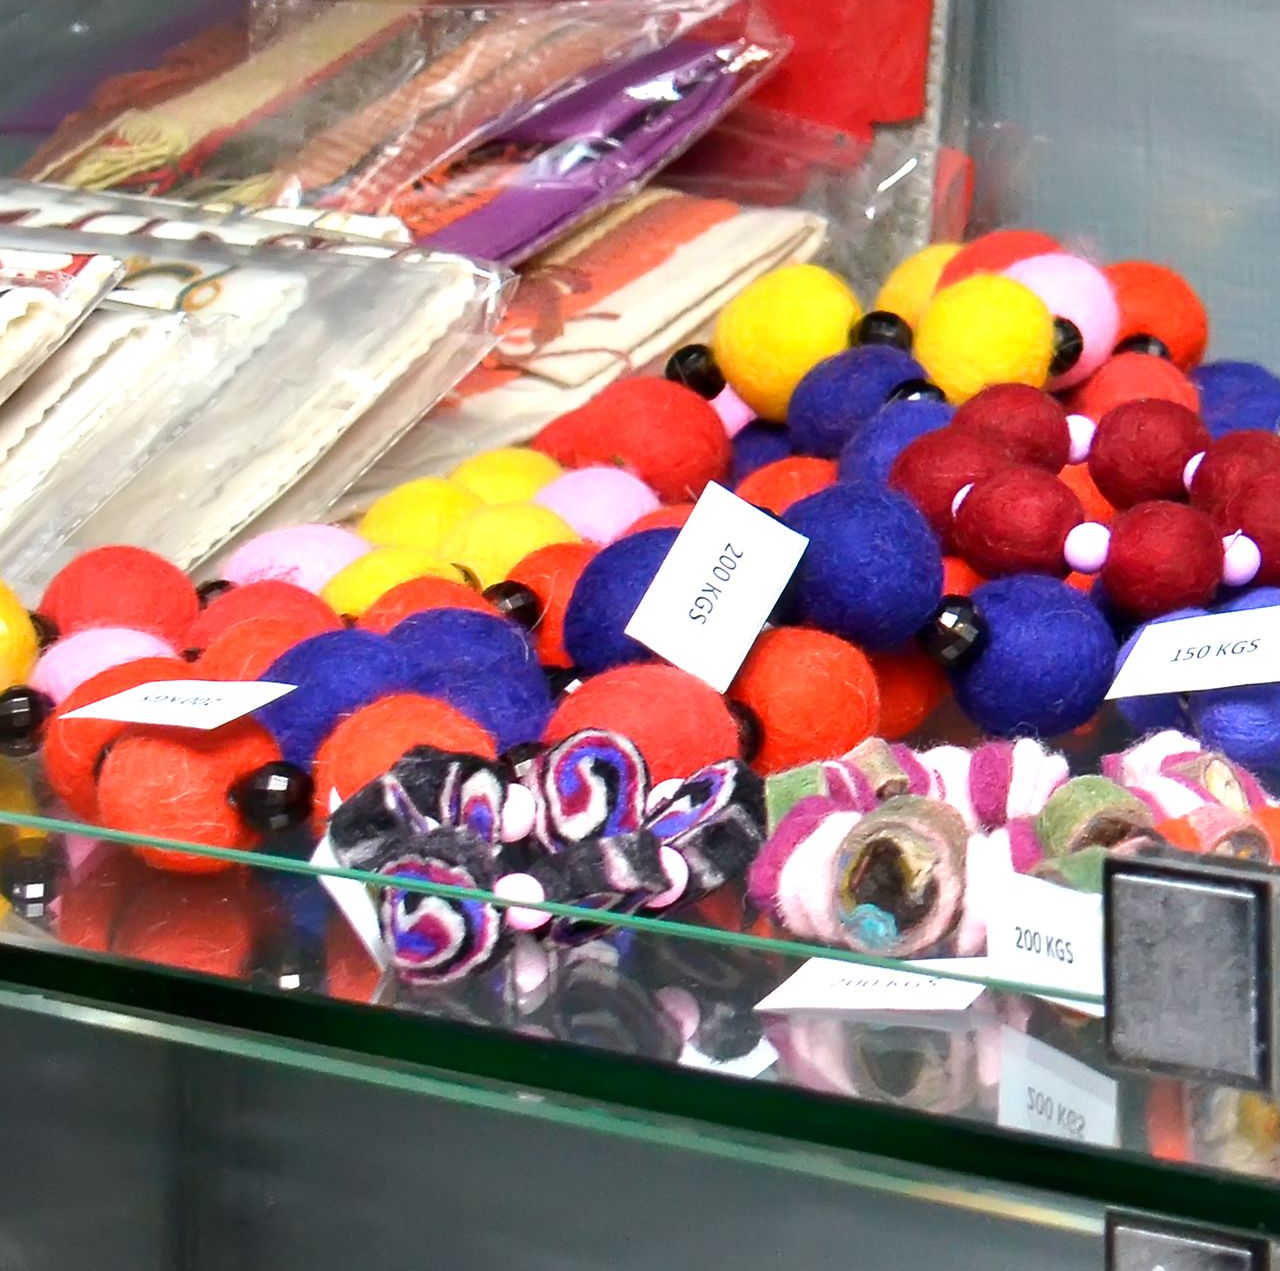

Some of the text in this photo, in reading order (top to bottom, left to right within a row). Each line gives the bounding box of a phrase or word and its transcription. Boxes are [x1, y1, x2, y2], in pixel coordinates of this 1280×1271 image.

[688, 542, 744, 625] 200 KGS
[1170, 638, 1261, 662] 150 KGS
[1015, 926, 1074, 964] 200 KGS
